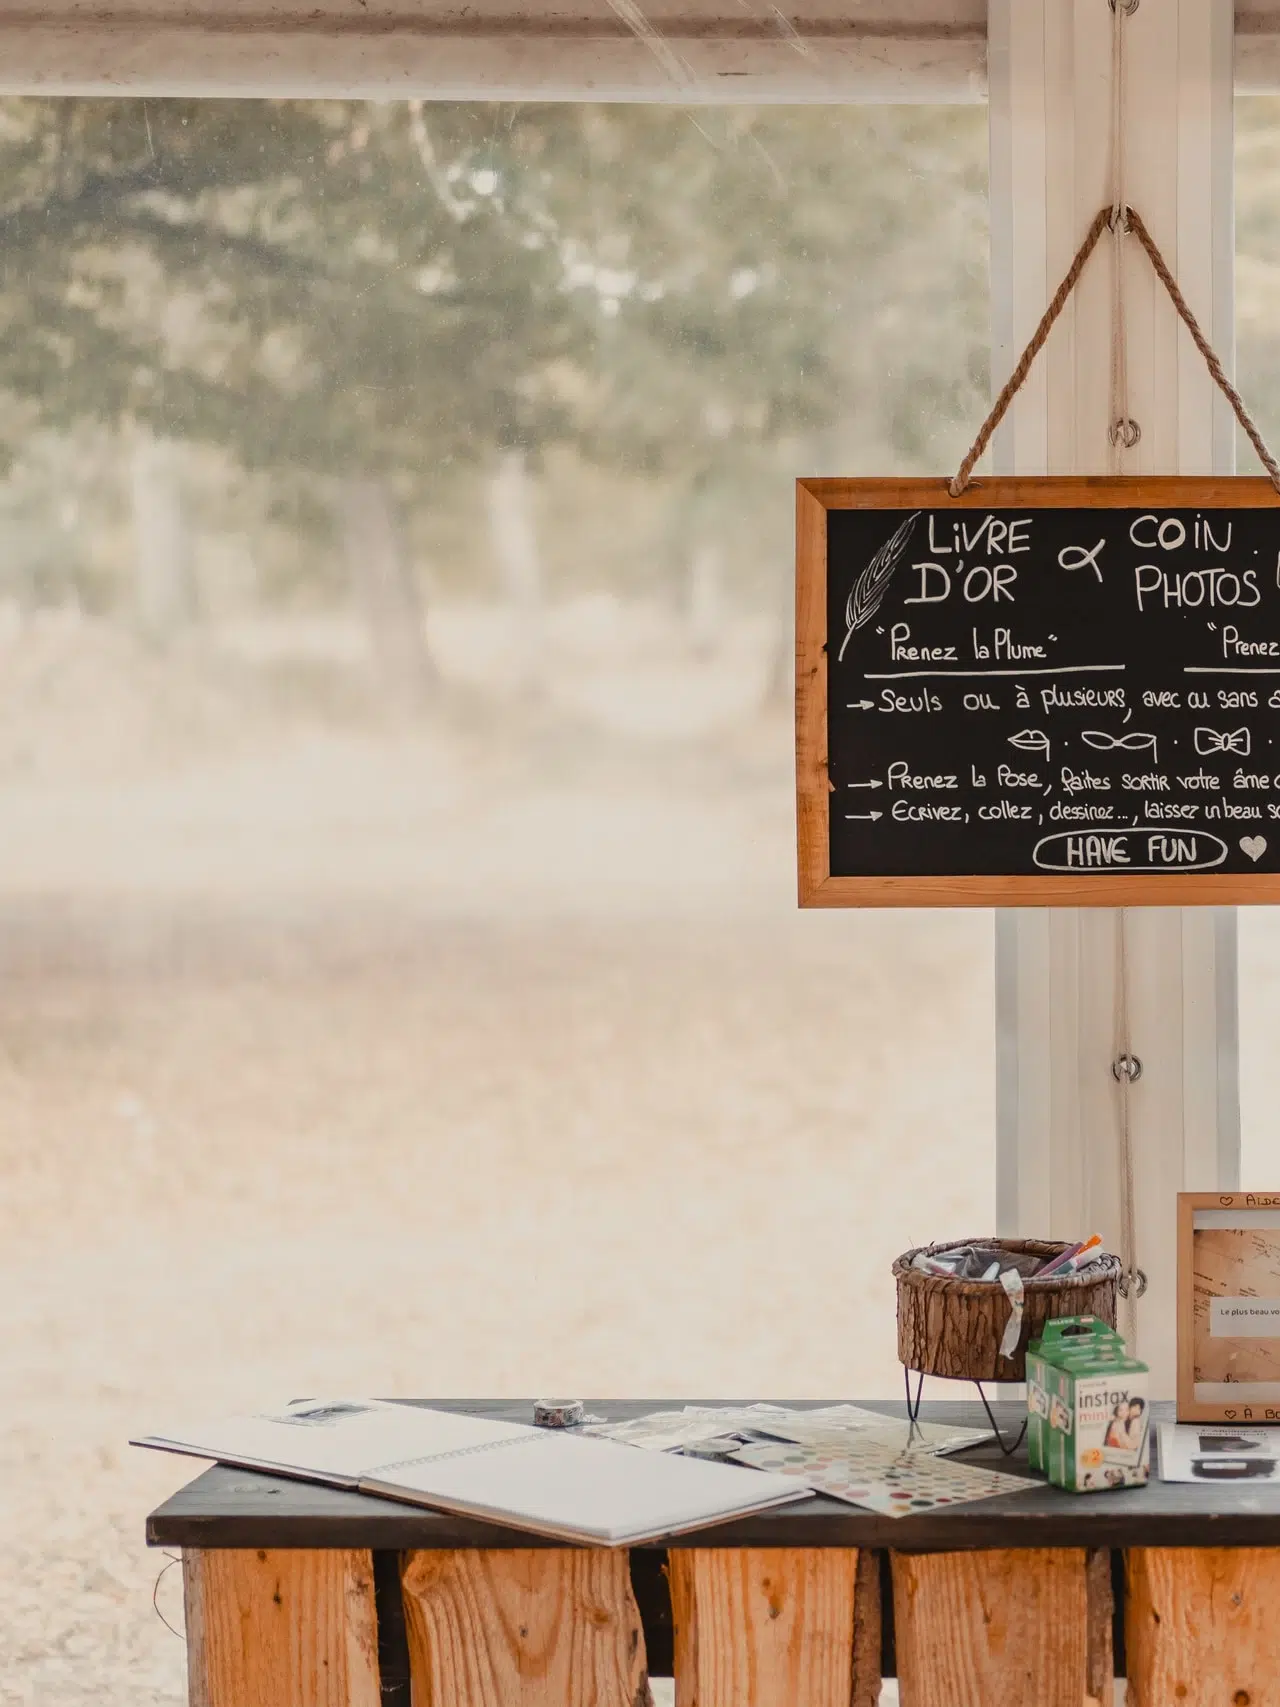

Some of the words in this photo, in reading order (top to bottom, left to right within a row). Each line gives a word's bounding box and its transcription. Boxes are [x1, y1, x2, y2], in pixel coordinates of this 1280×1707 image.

[904, 560, 1017, 604] D'OR
[1135, 565, 1260, 611] PHOTOS
[879, 688, 942, 712] Seuls
[964, 694, 1000, 710] ou
[1015, 685, 1030, 708] à
[1142, 691, 1181, 708] avec
[1218, 690, 1258, 708] sans
[972, 765, 986, 787] la
[1061, 767, 1111, 796] faites
[1176, 768, 1220, 789] votre
[1233, 768, 1269, 789] âme
[1145, 800, 1199, 819] laissez
[1223, 797, 1262, 819] beau
[1067, 836, 1130, 866] HAVE
[1148, 835, 1196, 862] FUN
[1231, 1308, 1248, 1317] plus
[1079, 1389, 1130, 1409] instax
[1079, 1409, 1109, 1423] mini
